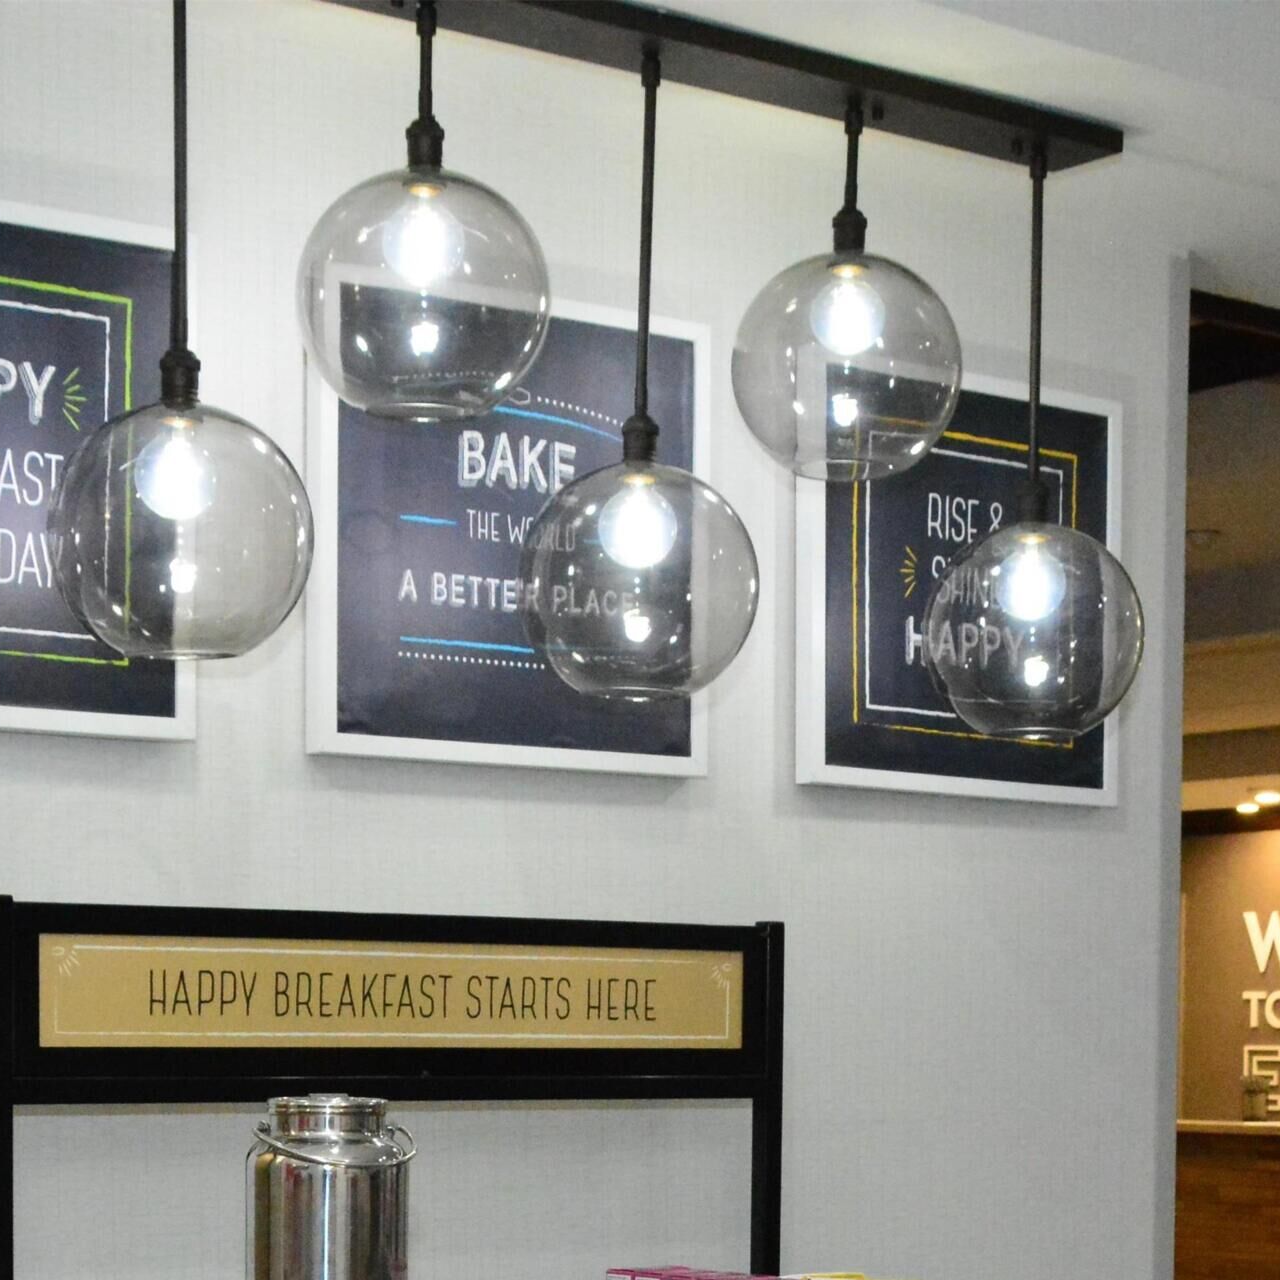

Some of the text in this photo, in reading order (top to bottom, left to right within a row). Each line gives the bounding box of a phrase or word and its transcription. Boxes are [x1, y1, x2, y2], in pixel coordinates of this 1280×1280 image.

[457, 430, 577, 494] BAKE
[466, 508, 501, 543] THE
[927, 492, 980, 544] RISE
[398, 568, 637, 618] A BETTER PLACE
[904, 614, 1026, 674] HAPPY
[148, 968, 658, 1022] HAPPY BREAKFAST STARTS HERE
